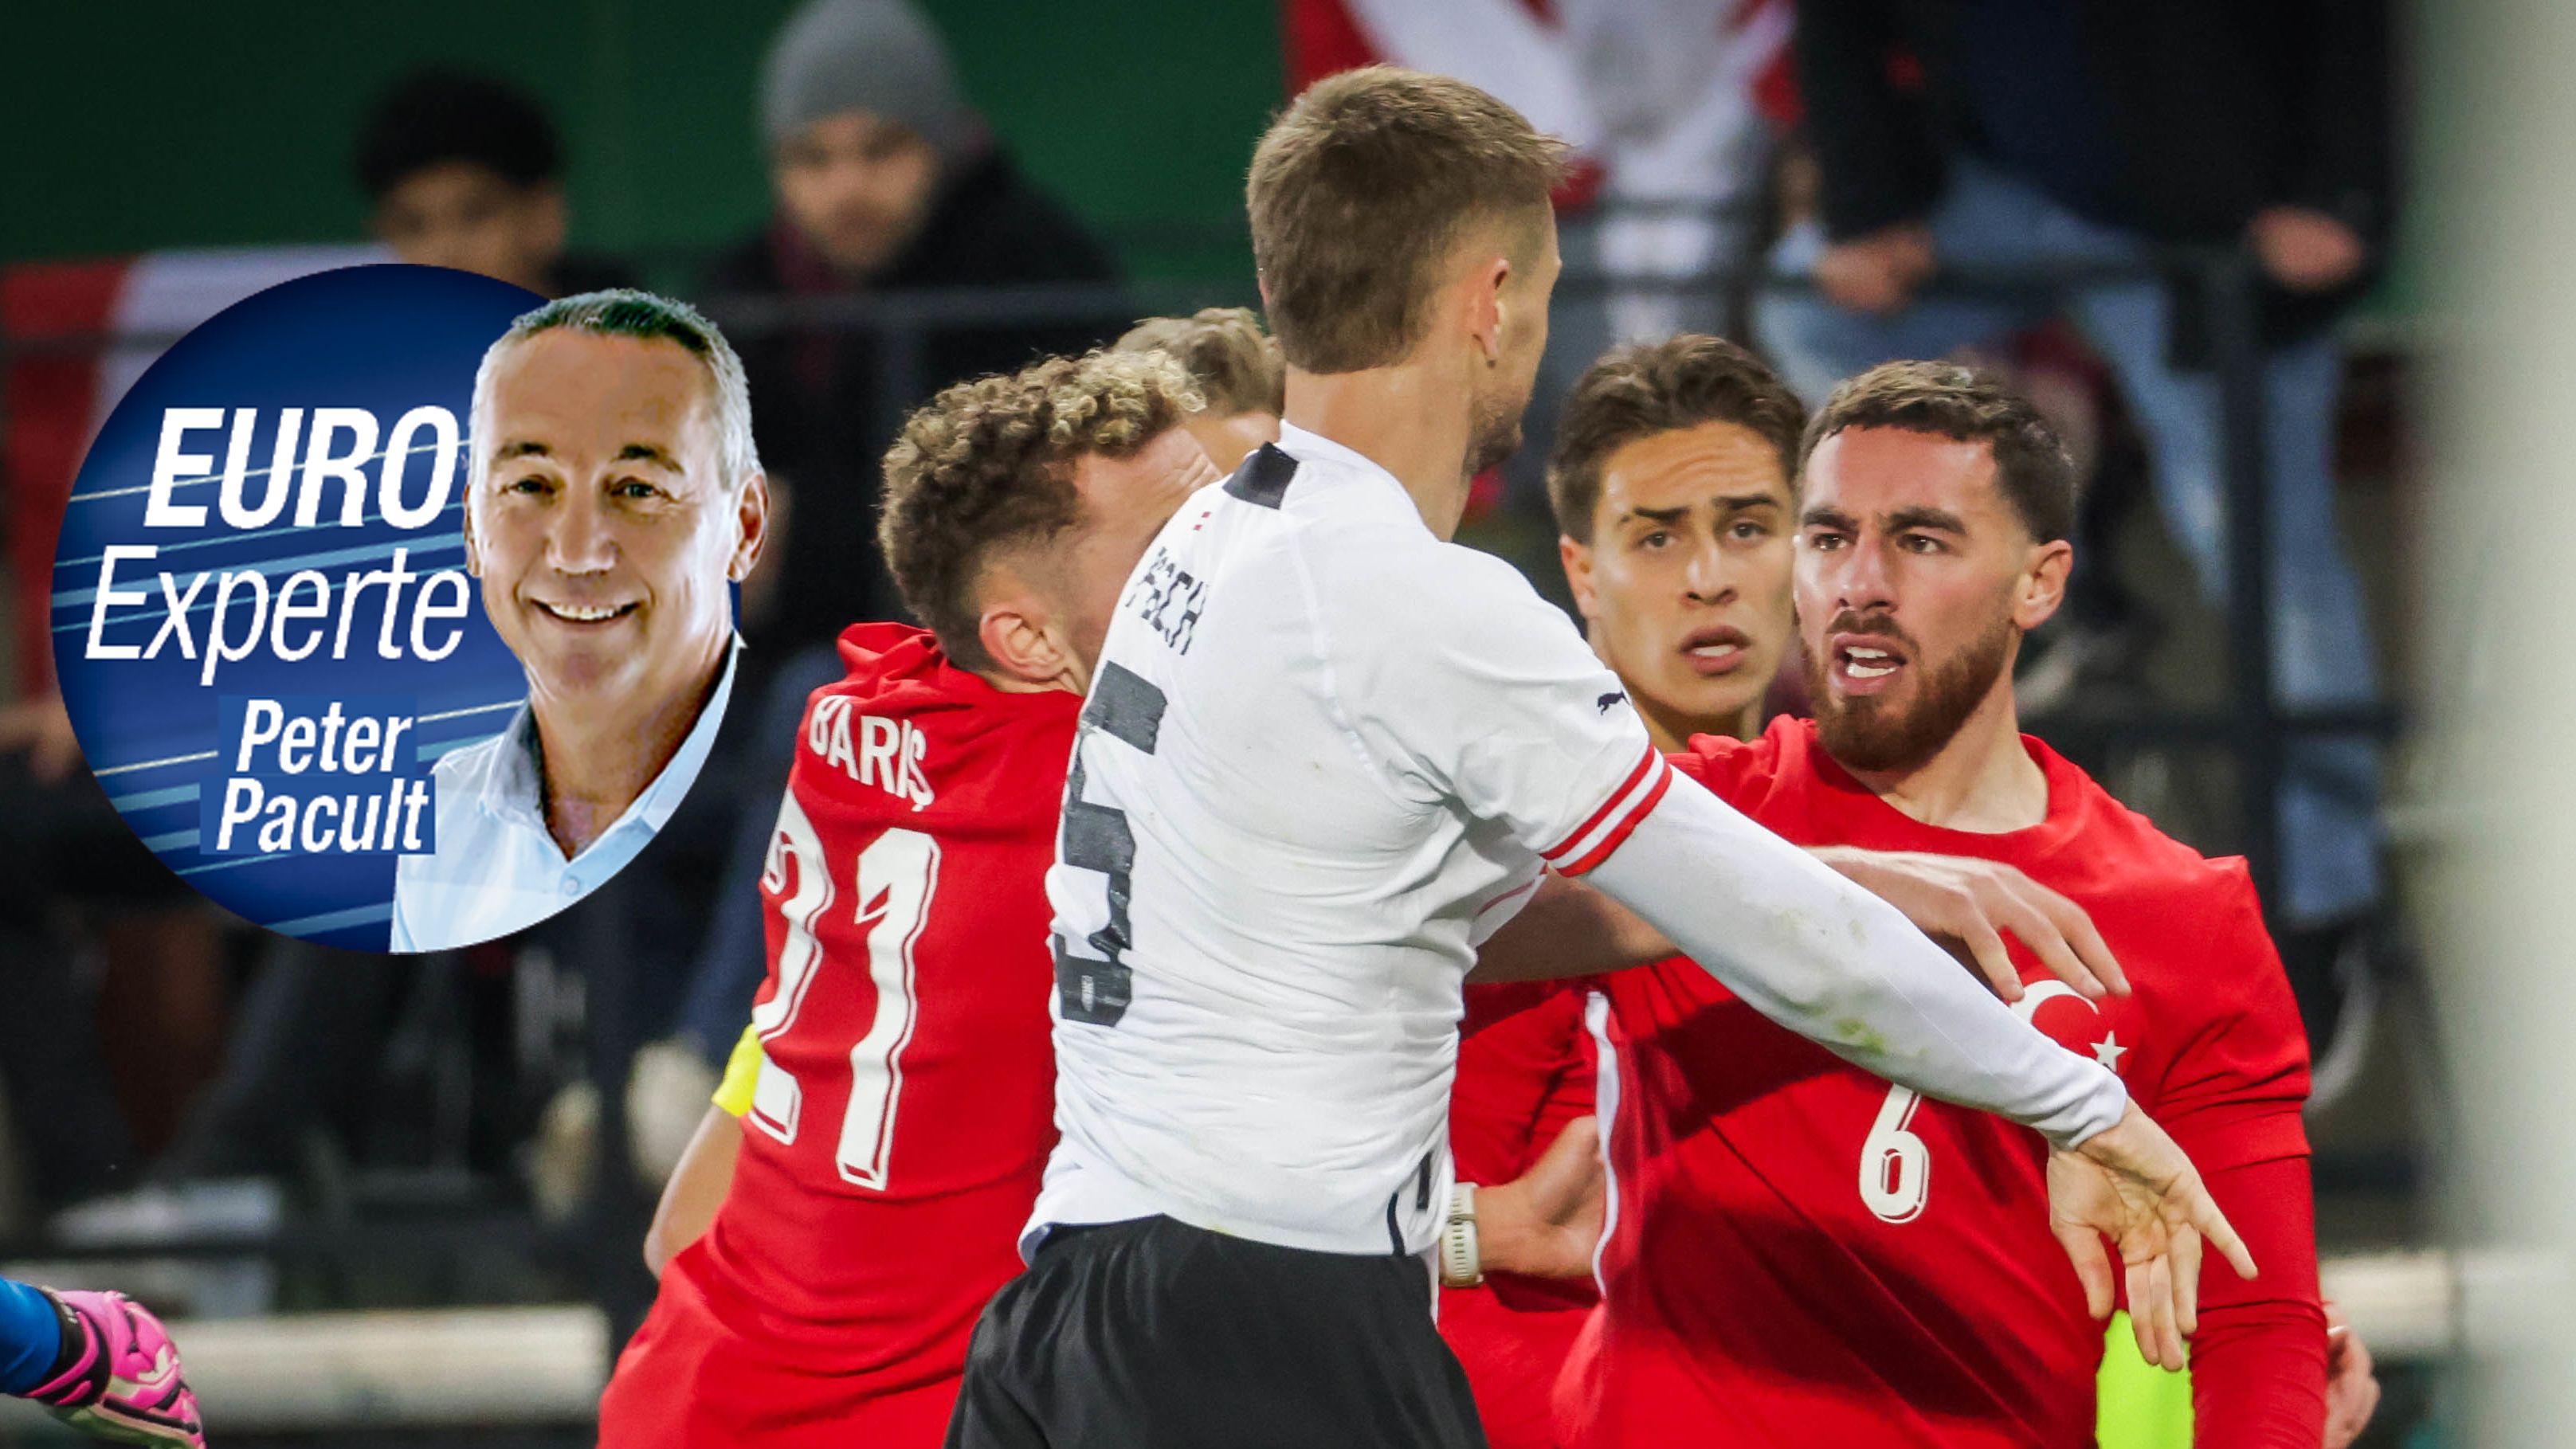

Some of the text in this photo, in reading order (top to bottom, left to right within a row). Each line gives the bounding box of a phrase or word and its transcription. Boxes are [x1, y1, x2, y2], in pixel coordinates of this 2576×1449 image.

[809, 694, 935, 813] BARIŞ
[1053, 660, 1168, 1028] 5
[747, 786, 941, 1192] 21
[1859, 1083, 1930, 1224] 6
